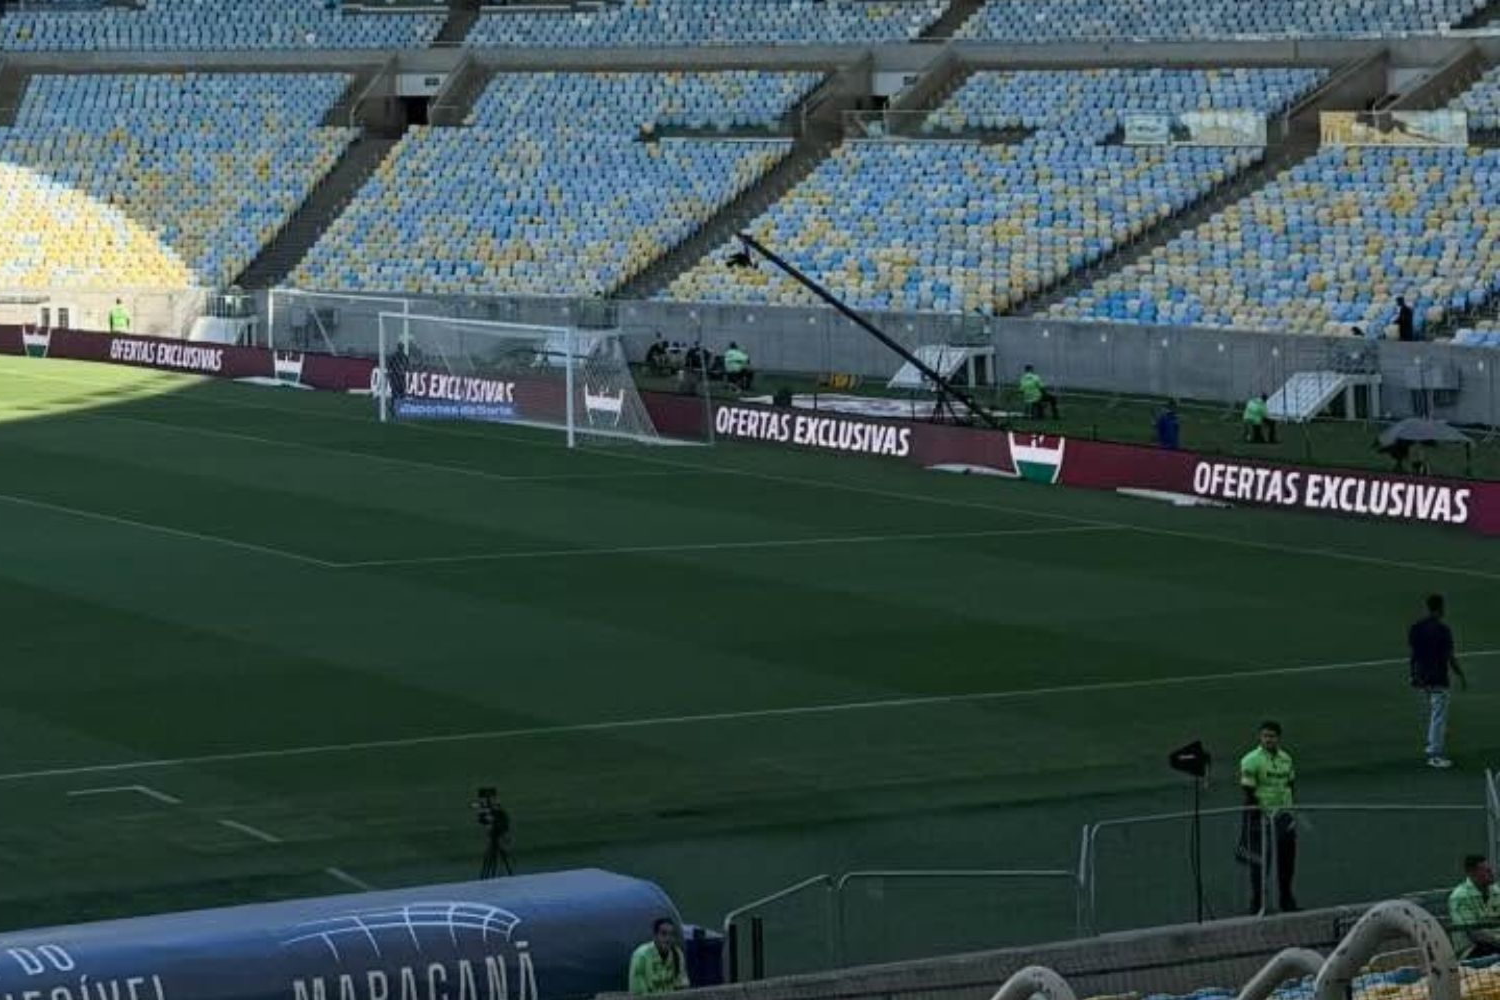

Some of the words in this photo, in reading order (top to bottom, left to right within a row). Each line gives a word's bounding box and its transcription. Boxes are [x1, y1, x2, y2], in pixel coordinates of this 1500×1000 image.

[110, 339, 156, 363] OFERTAS
[156, 343, 223, 371] EXCLUSIVAS
[716, 406, 790, 441] OFERTAS
[793, 416, 911, 457] EXCLUSIVAS
[1194, 462, 1299, 504] OFERTAS
[1305, 474, 1470, 523] EXCLUSIVAS
[7, 945, 76, 976] DO
